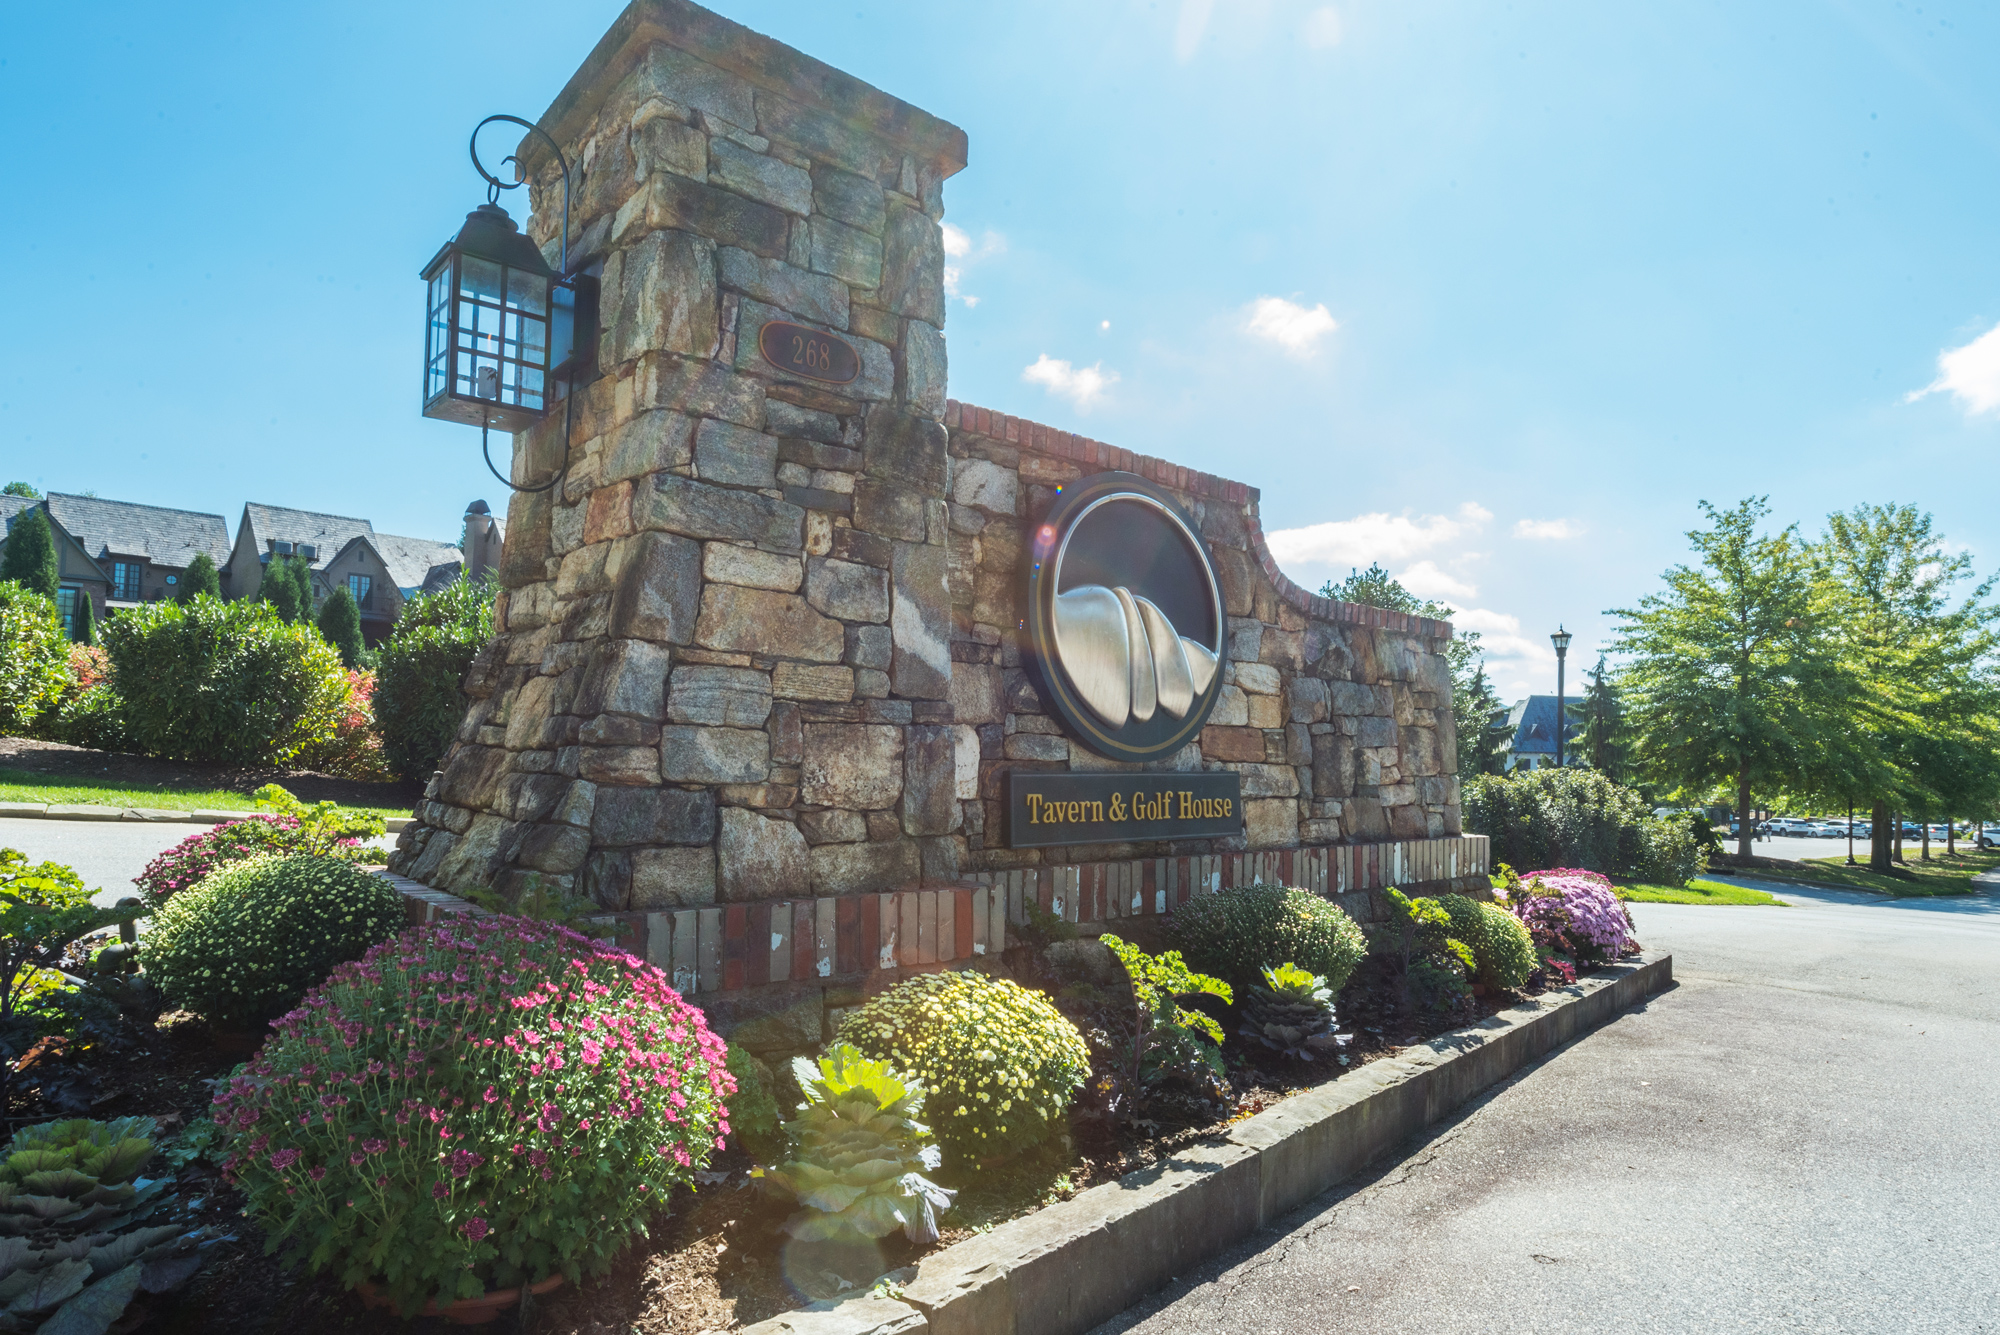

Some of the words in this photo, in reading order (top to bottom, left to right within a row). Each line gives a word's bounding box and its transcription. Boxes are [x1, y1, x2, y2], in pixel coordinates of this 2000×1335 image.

[792, 335, 830, 371] 268
[1027, 793, 1104, 824] Tavern
[1108, 792, 1128, 822] &
[1132, 791, 1174, 821] Golf
[1178, 791, 1232, 820] House
